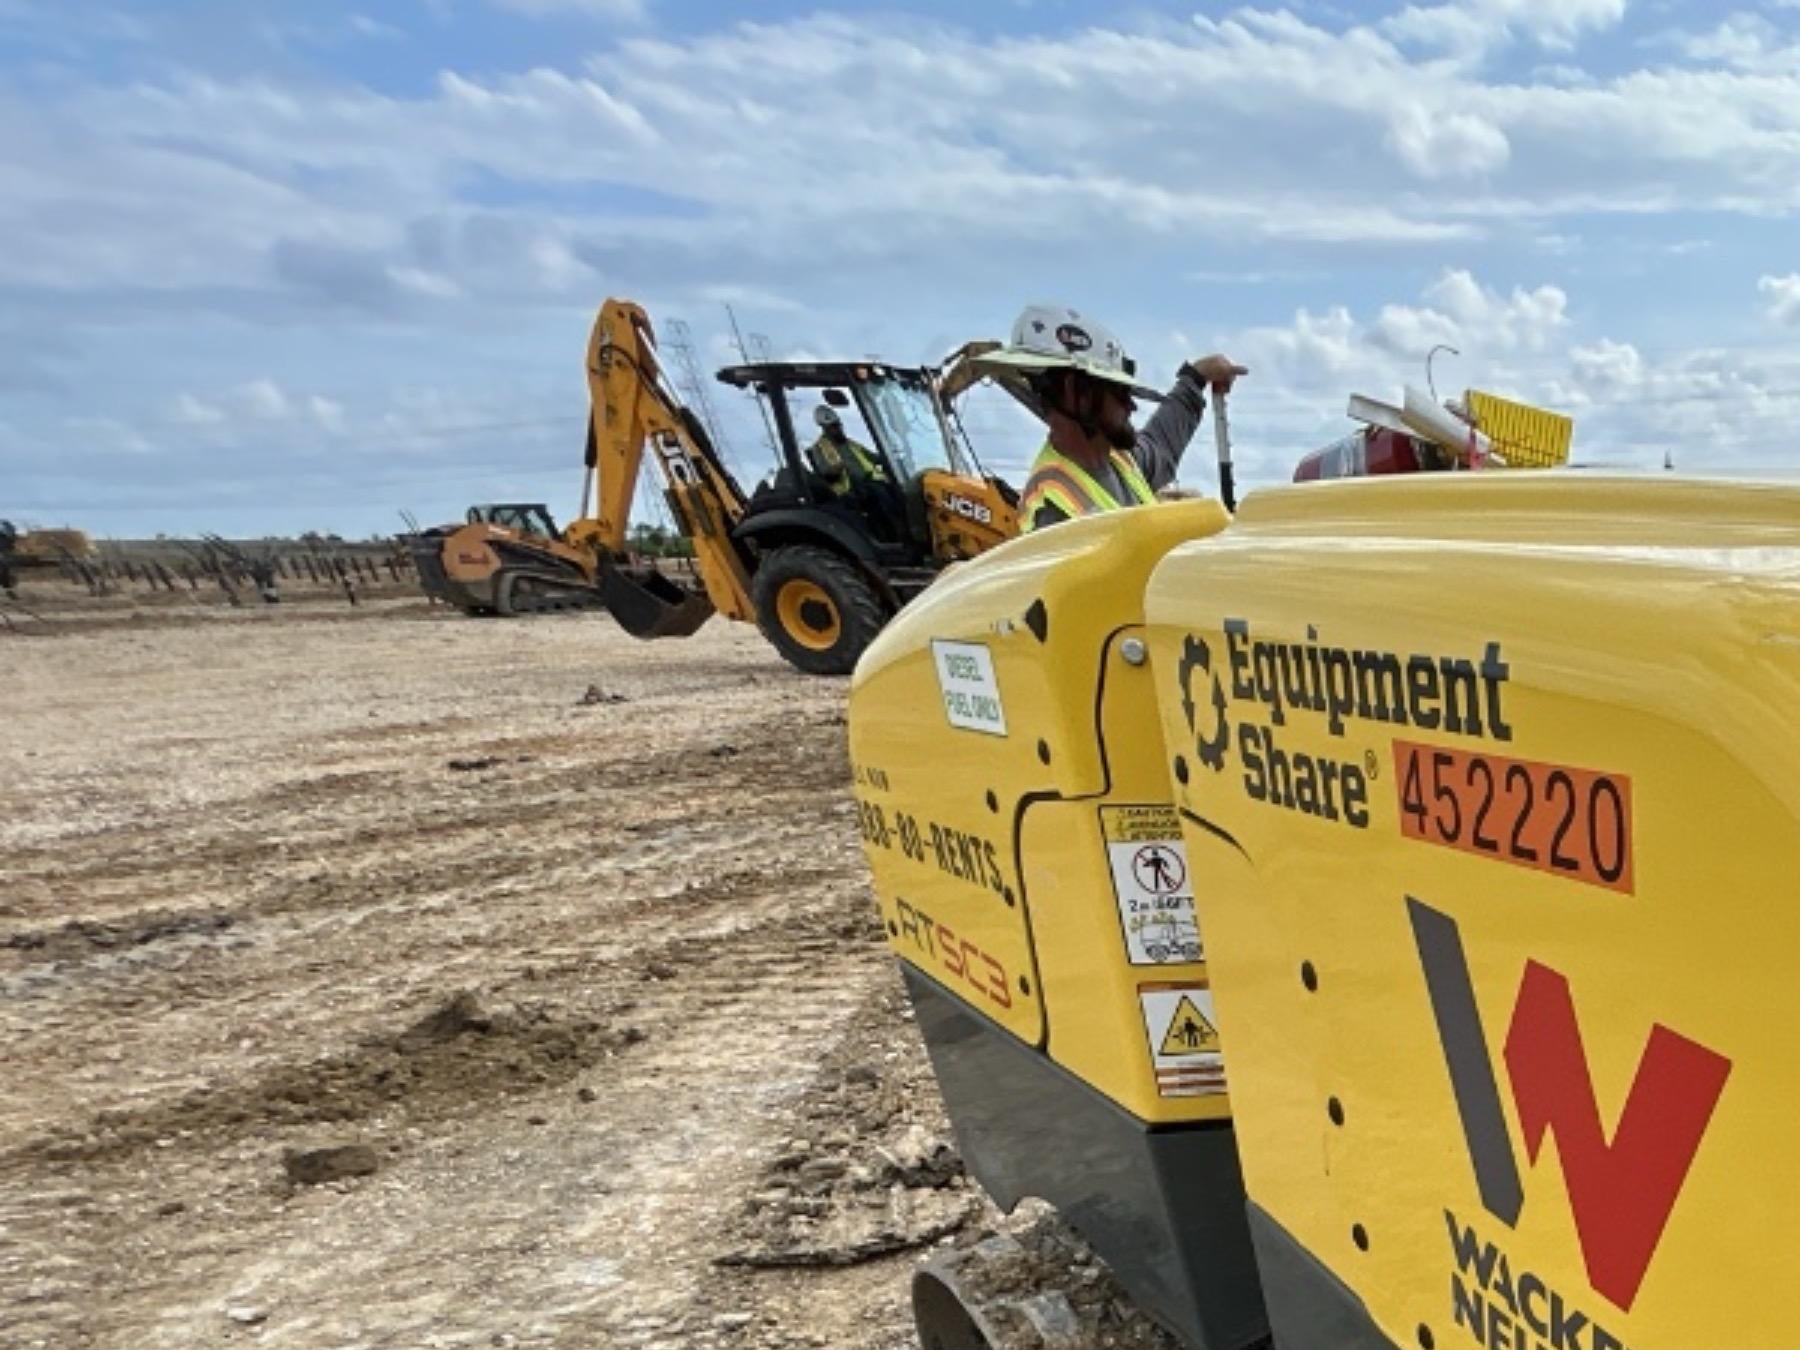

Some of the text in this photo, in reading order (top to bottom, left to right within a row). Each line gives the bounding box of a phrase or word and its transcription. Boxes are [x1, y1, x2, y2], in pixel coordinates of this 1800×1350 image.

[942, 494, 992, 523] JCB
[1223, 619, 1513, 741] Equipment
[1402, 749, 1625, 883] 452220
